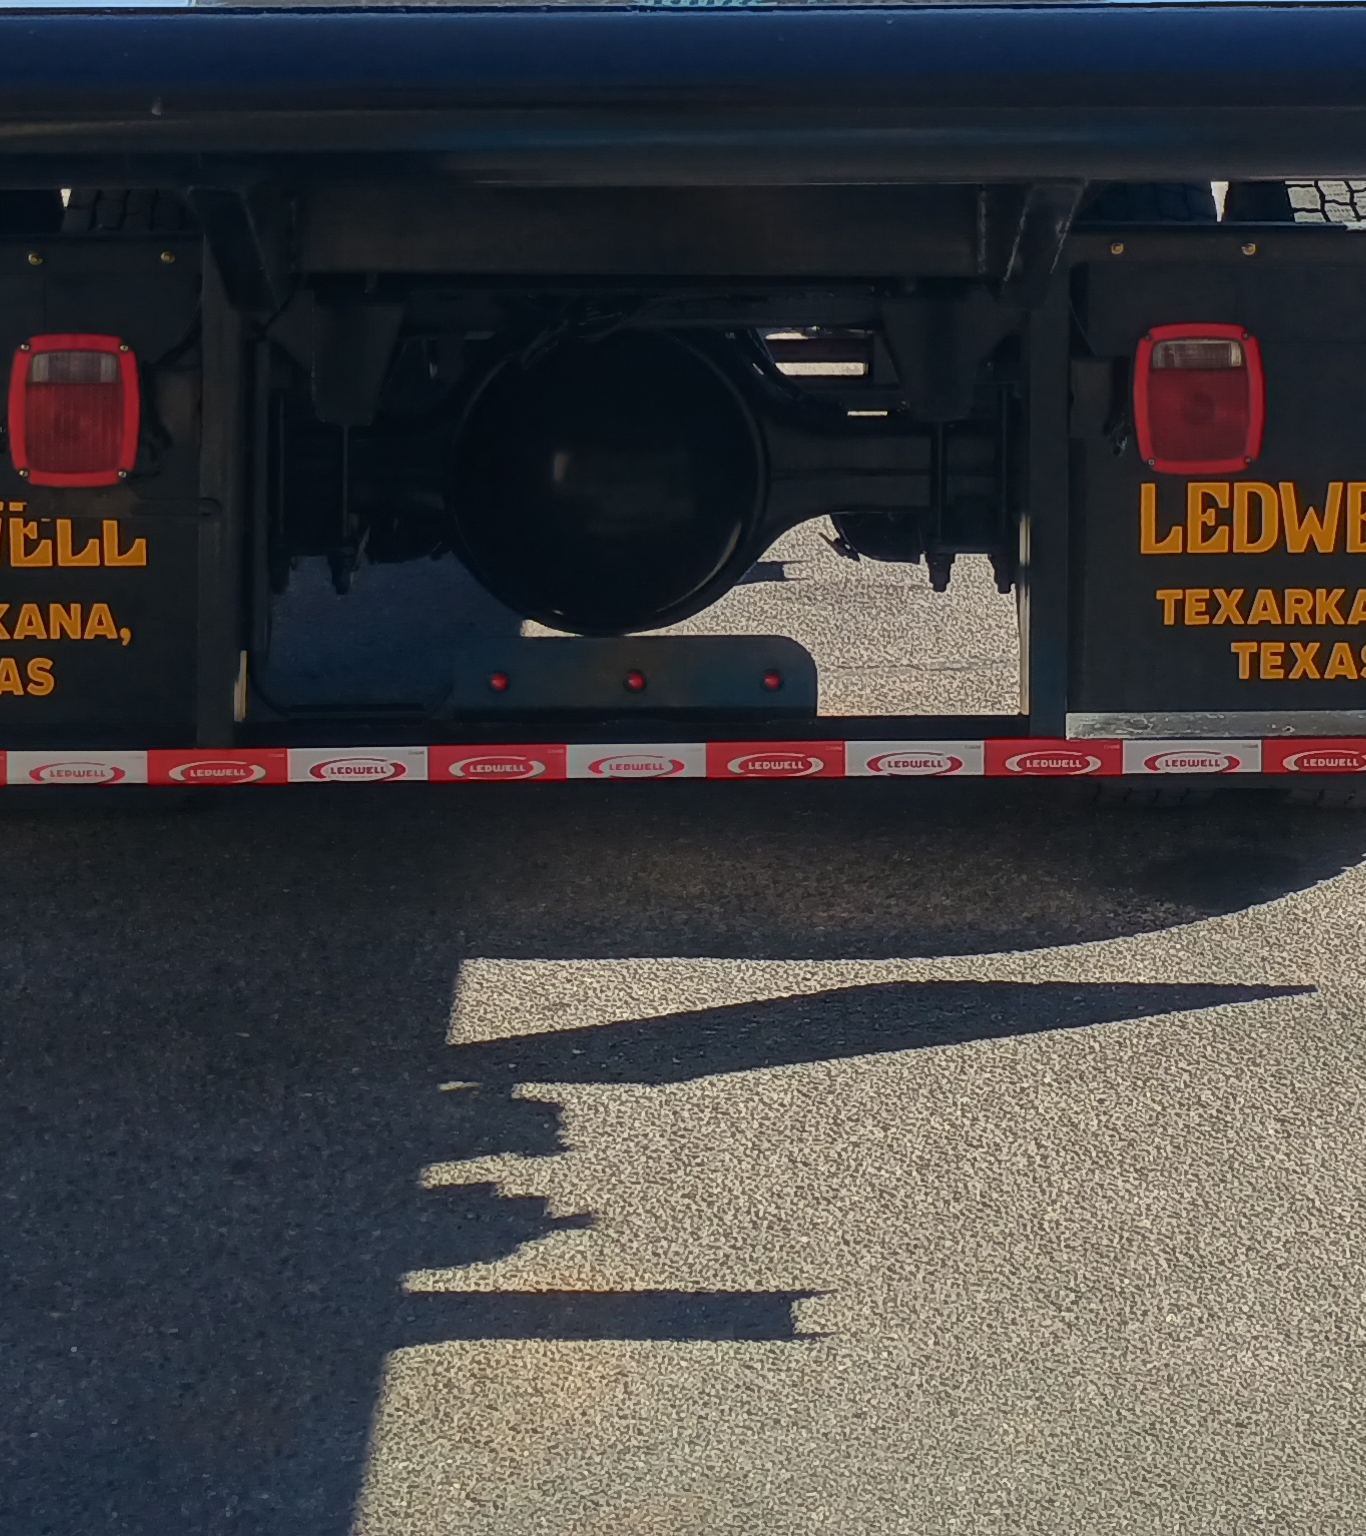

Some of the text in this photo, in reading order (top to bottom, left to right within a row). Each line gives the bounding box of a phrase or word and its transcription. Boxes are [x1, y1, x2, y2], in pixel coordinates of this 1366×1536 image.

[608, 762, 665, 772] LEDWELL
[747, 760, 805, 771] LEDWELL
[886, 759, 944, 769] LEDWELL
[1025, 759, 1083, 769] LEDWELL
[1164, 758, 1222, 769] LEDWELL
[1302, 757, 1361, 768] LEDWELL
[189, 768, 247, 778] LEDWELL
[329, 765, 387, 776] LEDWELL
[469, 763, 527, 773] LEDWELL
[49, 769, 107, 779] LEDWELL
